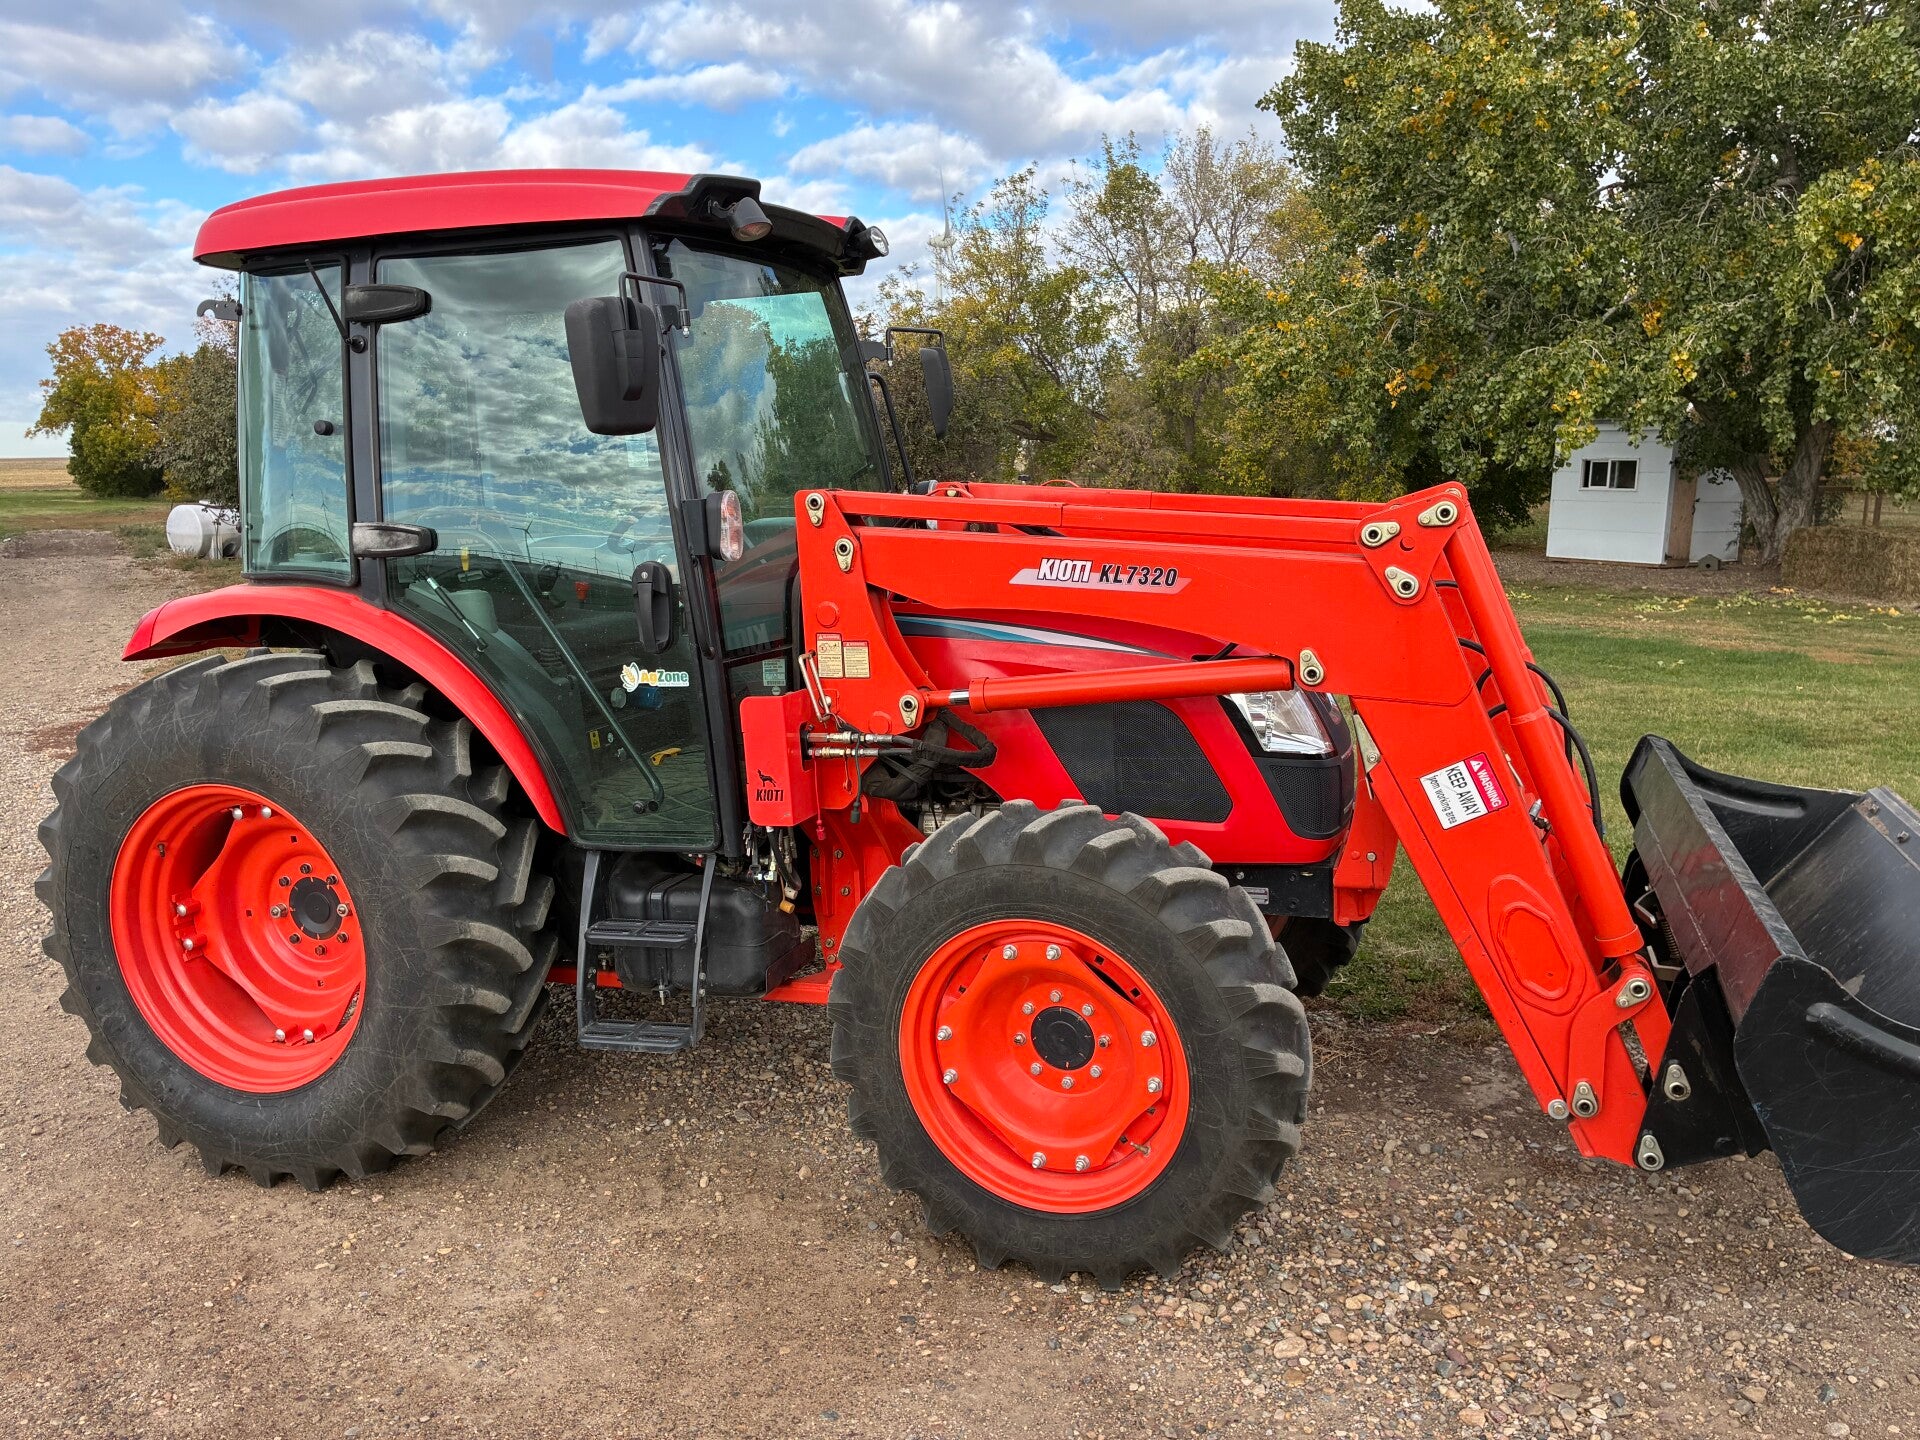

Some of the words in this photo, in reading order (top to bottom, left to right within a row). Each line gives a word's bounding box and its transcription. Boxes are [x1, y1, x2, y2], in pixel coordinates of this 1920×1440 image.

[1037, 557, 1093, 583] KIOTI
[1100, 564, 1178, 588] KL7320
[641, 669, 688, 685] AgZone
[756, 788, 784, 801] KIOTI
[1428, 774, 1440, 790] from
[1435, 788, 1451, 813] working
[1445, 811, 1457, 824] area
[1445, 765, 1467, 788] KEEP
[1456, 790, 1481, 815] AWAY
[1477, 769, 1502, 807] WARNING
